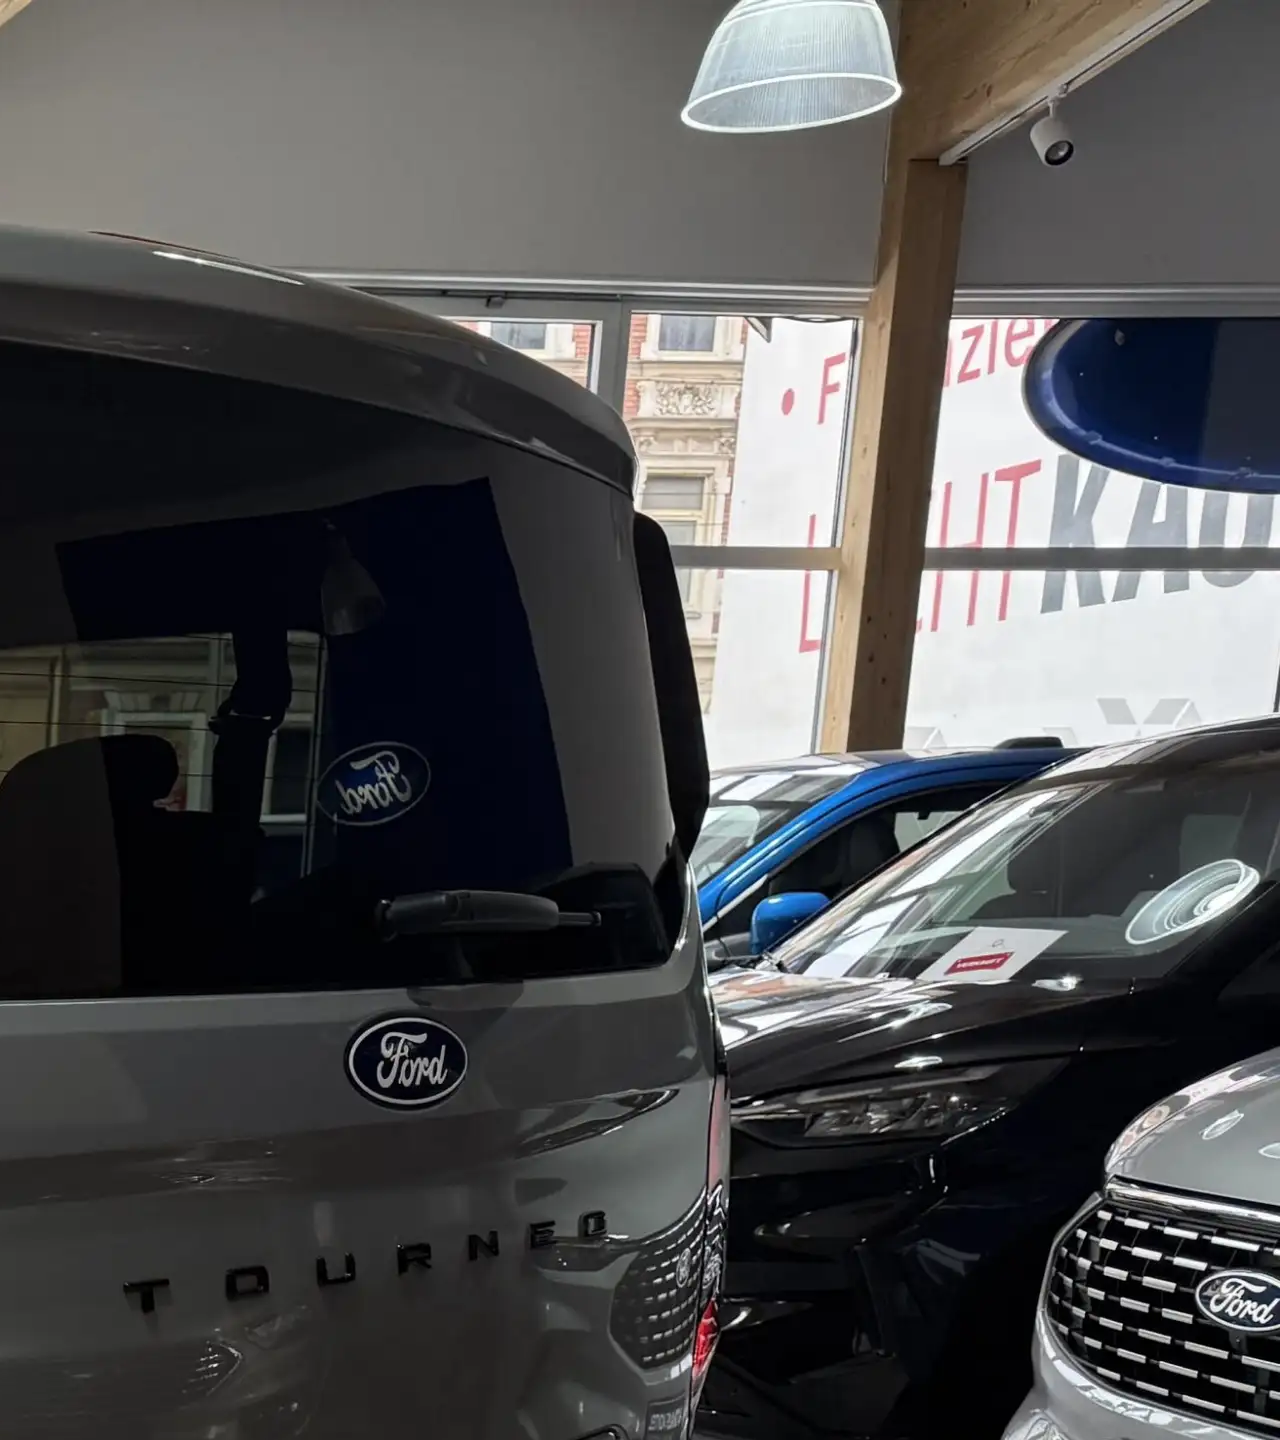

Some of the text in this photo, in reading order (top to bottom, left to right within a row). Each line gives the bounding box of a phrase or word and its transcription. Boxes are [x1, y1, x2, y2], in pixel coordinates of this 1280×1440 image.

[376, 1031, 448, 1088] Ford
[123, 1210, 608, 1314] TOURNEO
[1209, 1277, 1280, 1324] Ford
